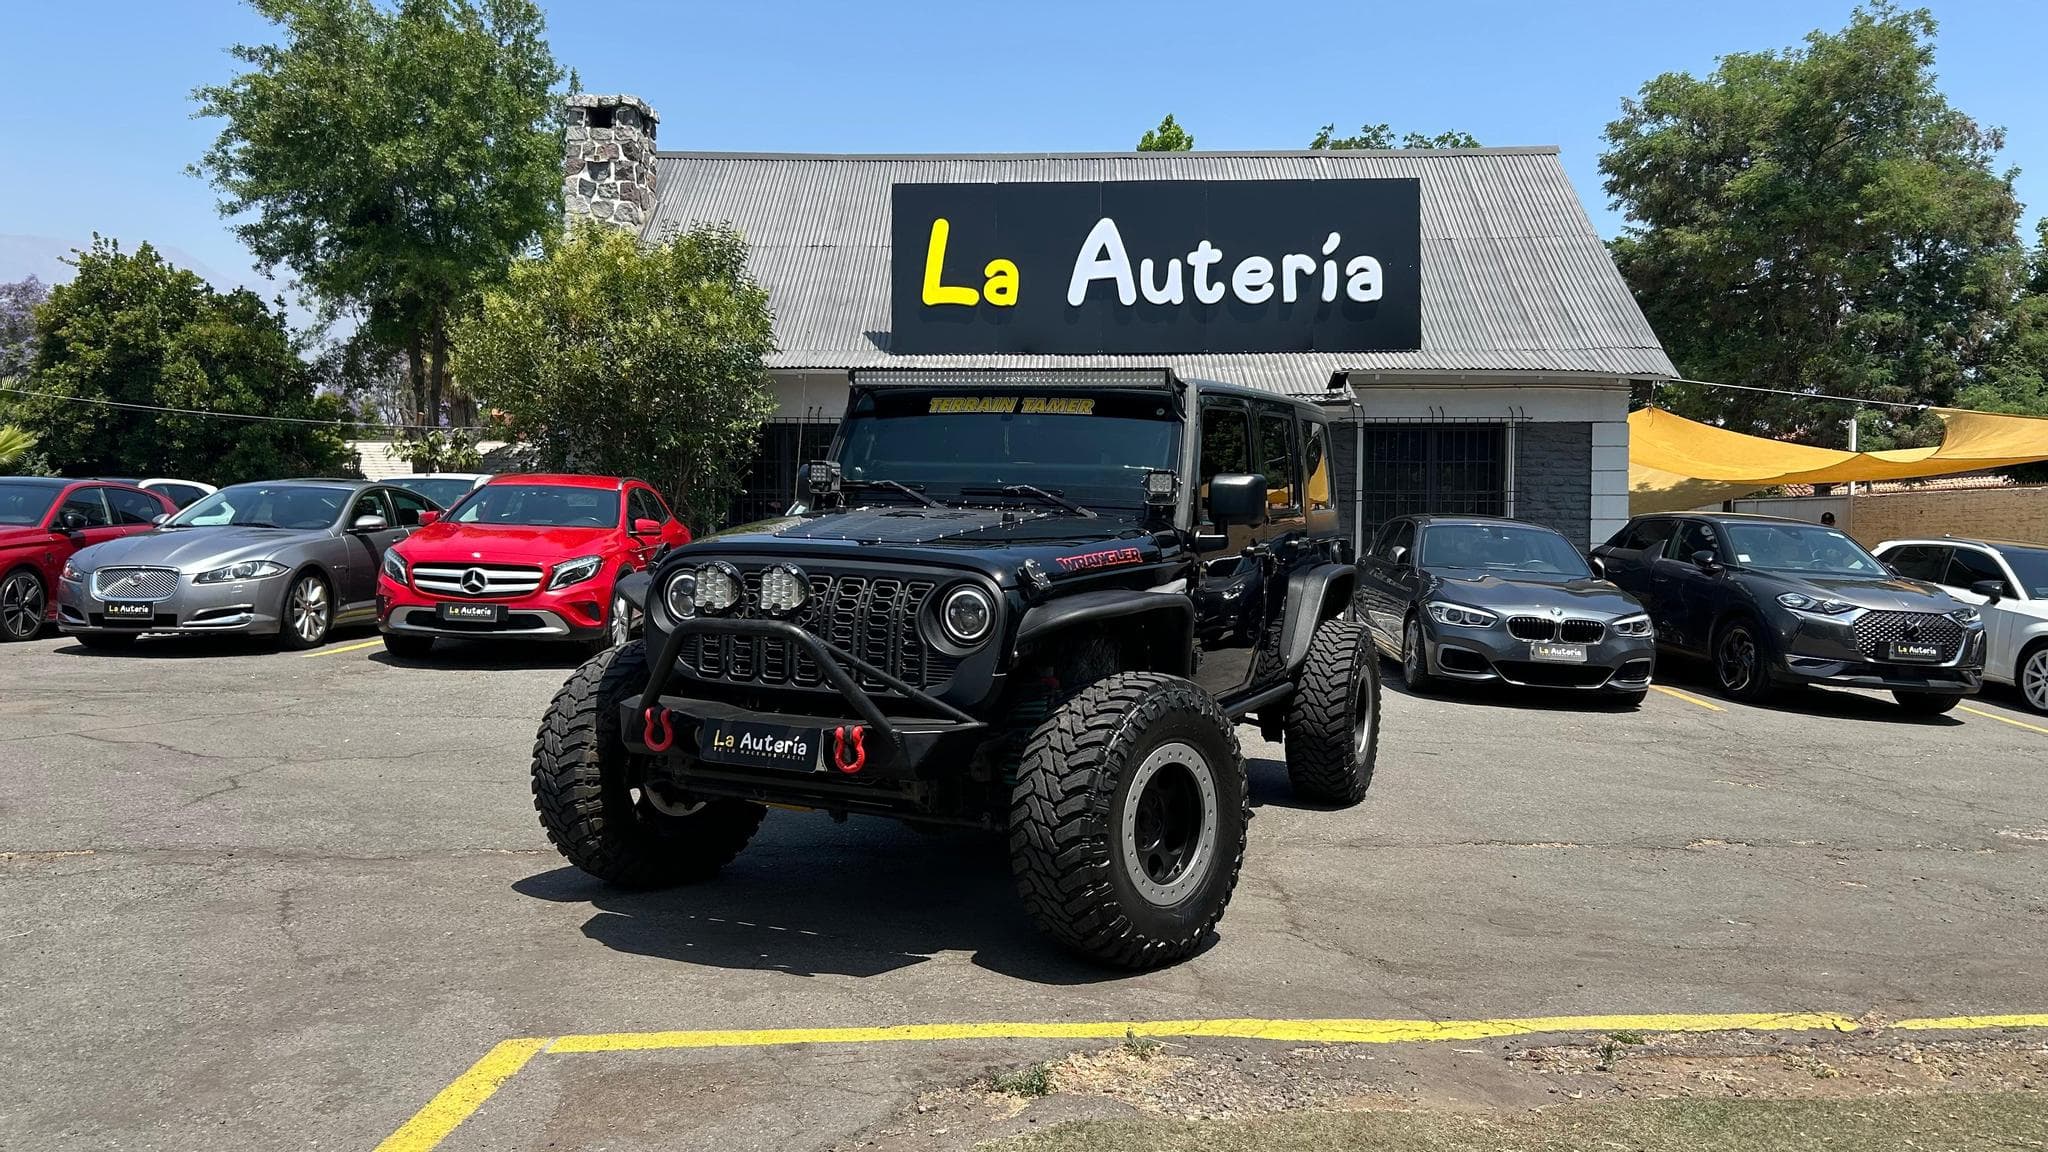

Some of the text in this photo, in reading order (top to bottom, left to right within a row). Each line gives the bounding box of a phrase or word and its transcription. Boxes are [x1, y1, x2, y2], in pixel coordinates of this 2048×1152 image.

[922, 217, 1384, 306] La Autería
[928, 396, 1095, 415] TERRAIN TAMER
[1056, 548, 1143, 571] WRANGLER
[714, 730, 807, 755] La Autería
